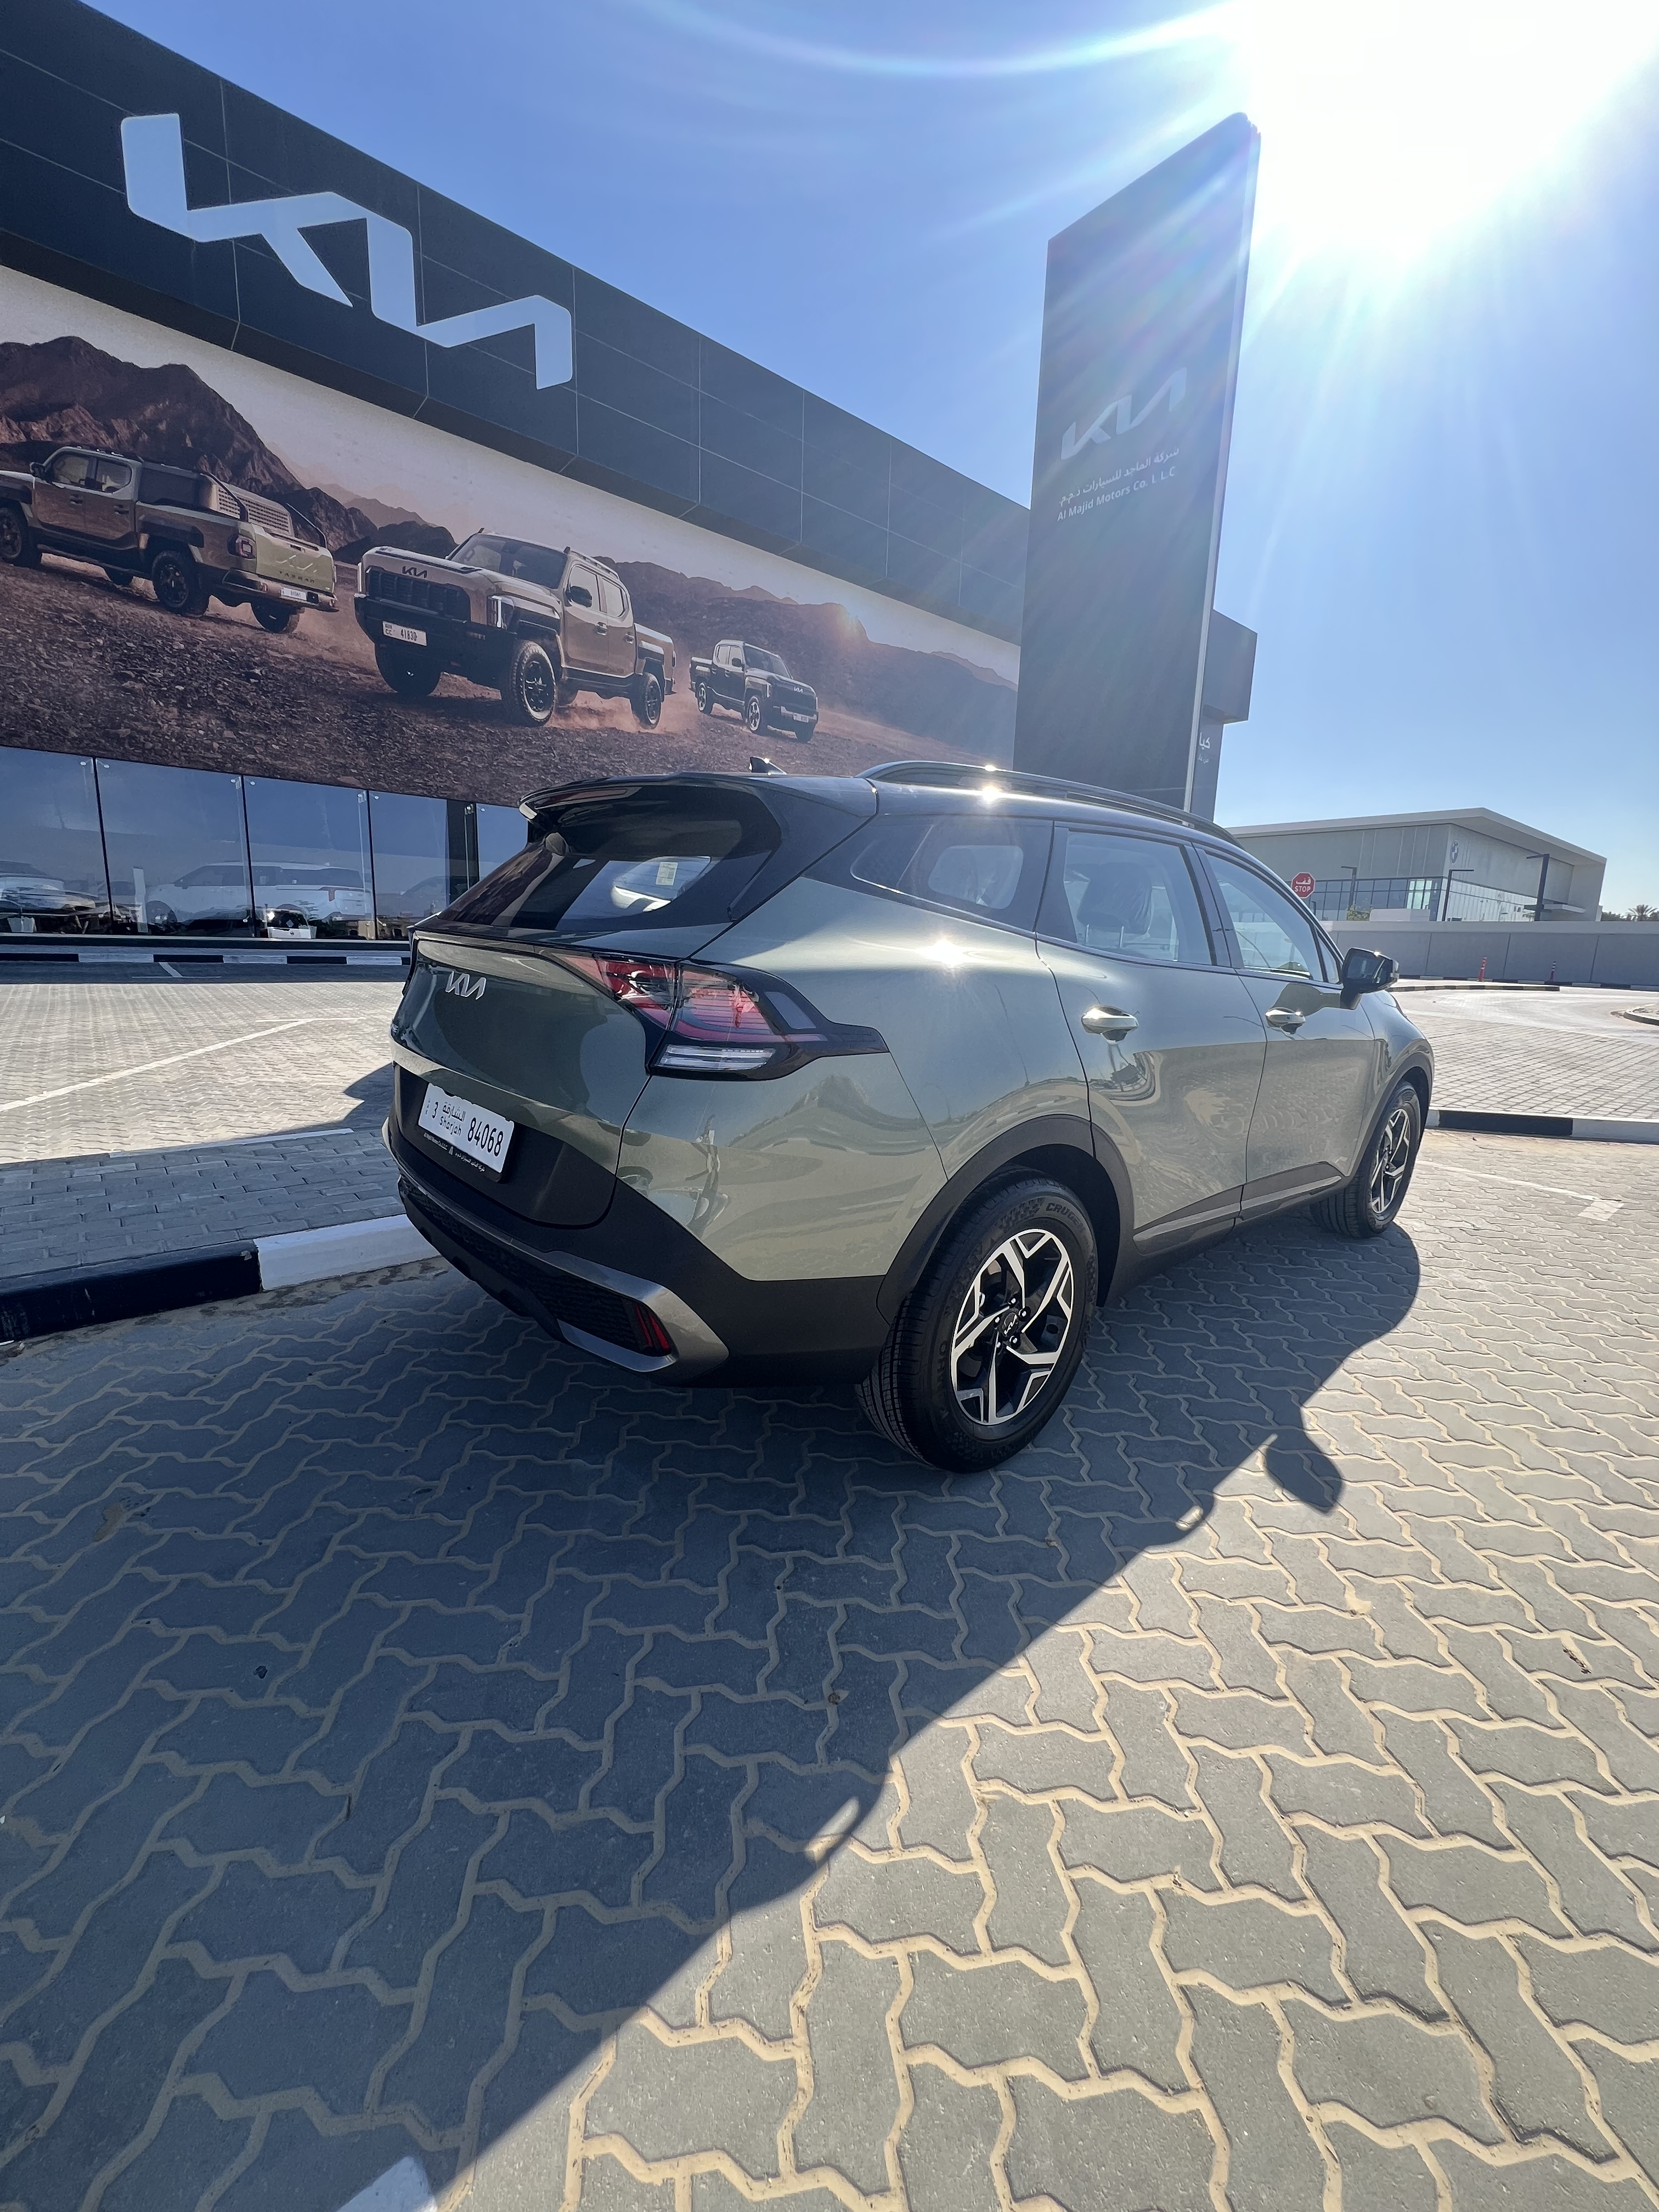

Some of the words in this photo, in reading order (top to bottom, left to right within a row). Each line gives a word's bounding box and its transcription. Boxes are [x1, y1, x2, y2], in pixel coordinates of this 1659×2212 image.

[121, 113, 572, 390] KIA
[1060, 366, 1187, 460] KIA
[1082, 469, 1122, 493] للسيارات
[1057, 509, 1066, 522] Al
[1068, 498, 1094, 517] Majid
[1096, 486, 1131, 506] Motors
[1133, 480, 1148, 491] Co.
[402, 566, 428, 579] KIA
[1199, 732, 1210, 751] كيا
[1295, 876, 1311, 885] قف
[445, 970, 487, 1000] KIA
[432, 1102, 438, 1119] 3
[442, 1101, 466, 1122] الشارقة
[439, 1115, 462, 1136] Sharjah
[467, 1116, 504, 1157] 84068
